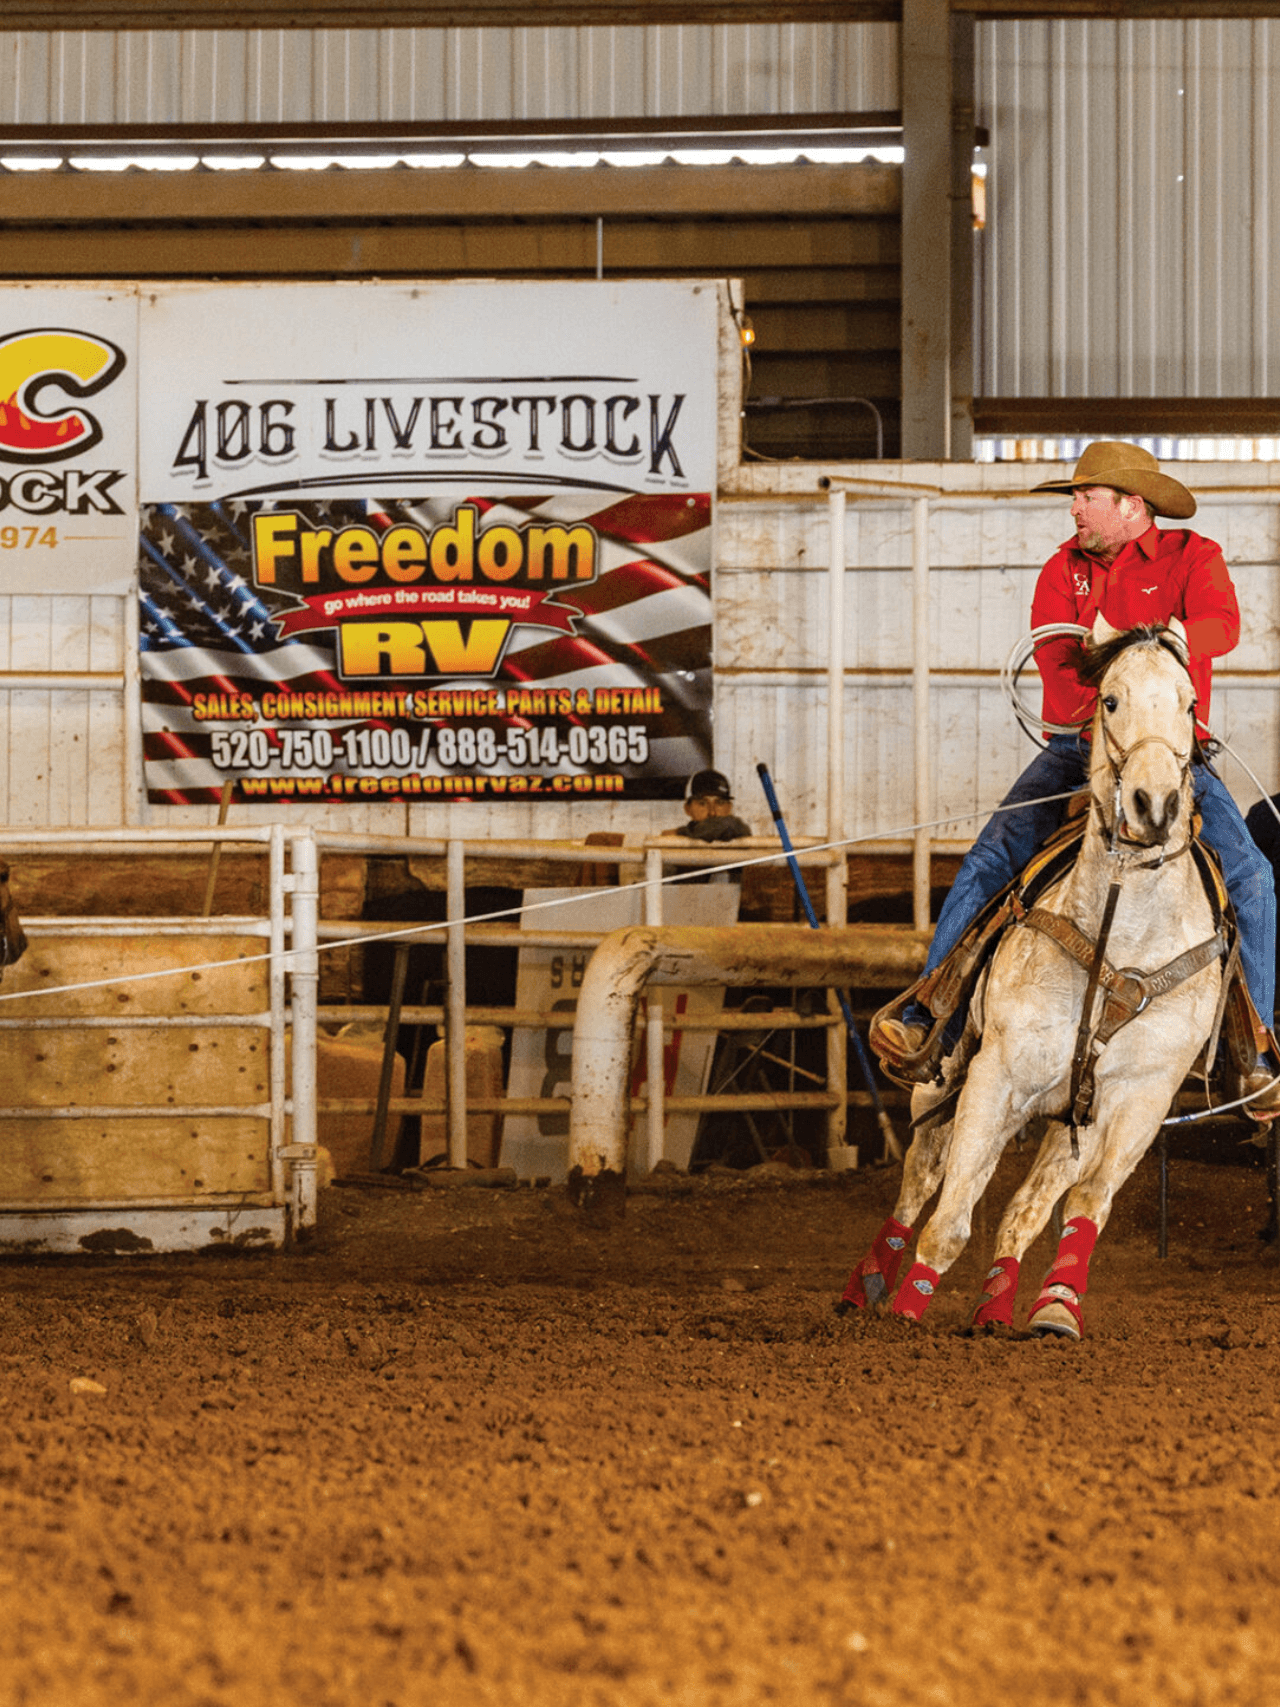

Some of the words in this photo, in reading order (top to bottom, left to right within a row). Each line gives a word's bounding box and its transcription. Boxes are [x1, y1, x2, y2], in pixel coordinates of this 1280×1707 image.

[171, 398, 296, 480] 406
[321, 394, 688, 478] LIVESTOCK
[253, 506, 598, 585] Freedom
[324, 599, 343, 616] go
[345, 593, 392, 608] where
[395, 589, 419, 604] the
[421, 588, 456, 604] road
[457, 589, 497, 606] takes
[499, 594, 531, 610] you!
[341, 619, 511, 676] RV
[193, 692, 259, 724] SALES,
[261, 691, 411, 722] CONSIGNMENT,
[507, 688, 572, 716] PARTS
[575, 688, 593, 715] &
[595, 687, 663, 716] DETAIL
[211, 728, 411, 768] 520-750-1100
[437, 725, 649, 767] 888-514-0365
[240, 773, 624, 796] www.freedomrvaz.com
